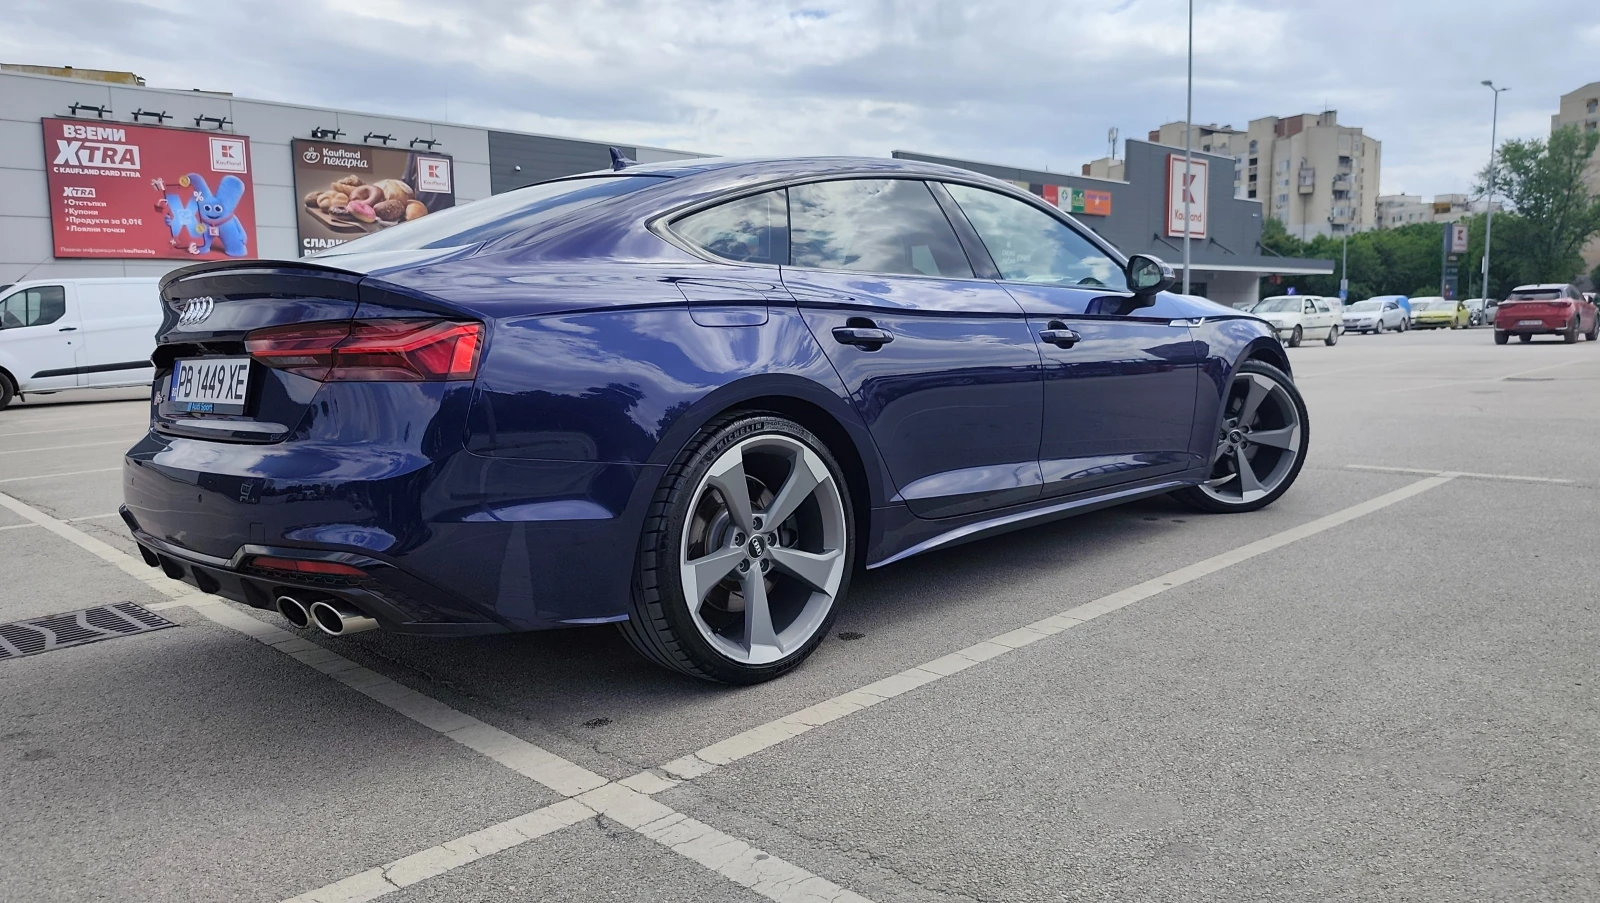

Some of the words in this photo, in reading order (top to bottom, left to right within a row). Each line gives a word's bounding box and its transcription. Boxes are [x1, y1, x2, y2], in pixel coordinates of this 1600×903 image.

[63, 124, 126, 142] ВЗЕМИ
[53, 139, 141, 170] XTRA
[322, 148, 361, 159] Kaufland
[323, 156, 369, 169] пекарна
[60, 167, 99, 176] KAUFLAND
[100, 169, 121, 177] CARD
[63, 186, 96, 198] XTRA
[68, 199, 107, 207] Отстъпки
[68, 208, 99, 216] Купони
[1174, 209, 1203, 223] Kaand
[69, 216, 110, 225] Продукти
[121, 218, 143, 226] 0,01€
[70, 225, 101, 233] Лоялни
[177, 365, 193, 398] PB
[196, 364, 226, 399] 1449
[225, 364, 248, 400] XE
[200, 402, 213, 412] Sport
[716, 422, 763, 452] MICHELIN
